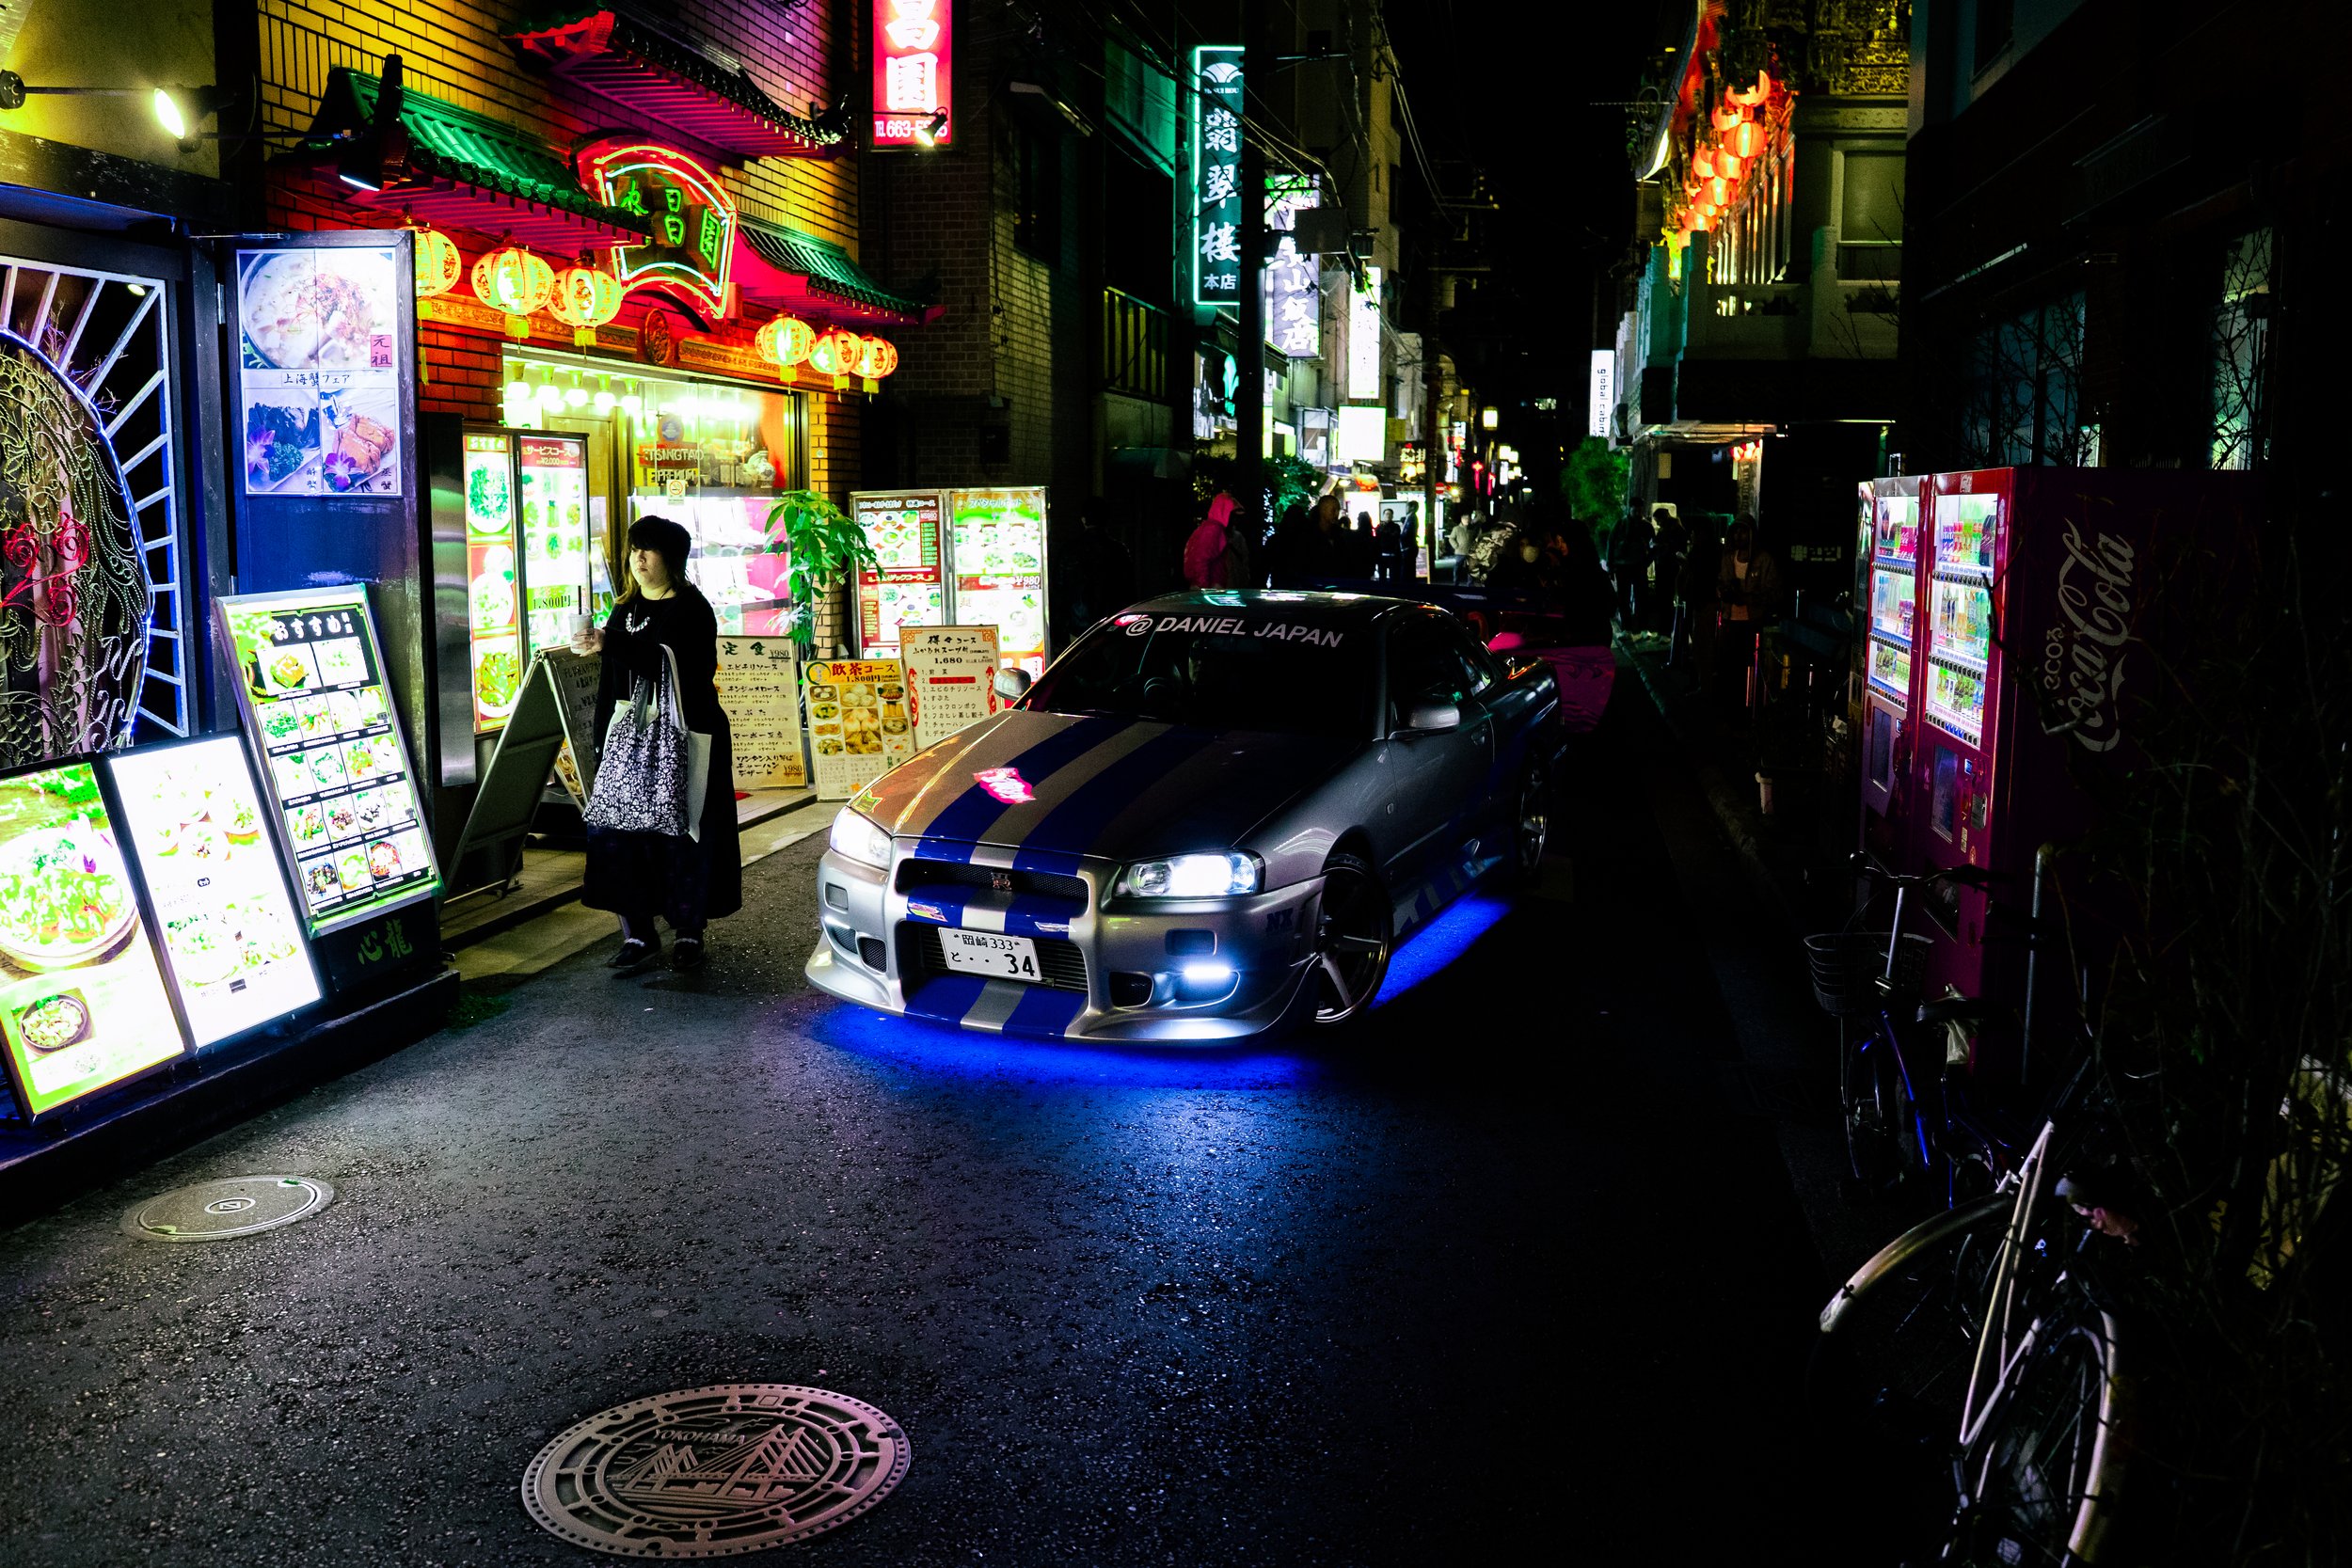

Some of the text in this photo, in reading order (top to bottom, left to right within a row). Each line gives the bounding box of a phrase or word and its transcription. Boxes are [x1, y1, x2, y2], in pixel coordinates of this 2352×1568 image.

[1203, 273, 1237, 290] 本店
[371, 335, 392, 365] 元祖
[284, 373, 350, 387] 上海蟹フェア
[1597, 368, 1609, 400] global
[1155, 617, 1247, 636] DANIEL
[1254, 622, 1343, 648] JAPAN
[722, 641, 766, 656] 定食
[832, 663, 895, 676] 飲茶コース
[961, 934, 1014, 951] 岡崎 333
[951, 952, 961, 962] と
[654, 1429, 745, 1445] YOKOHAMA
